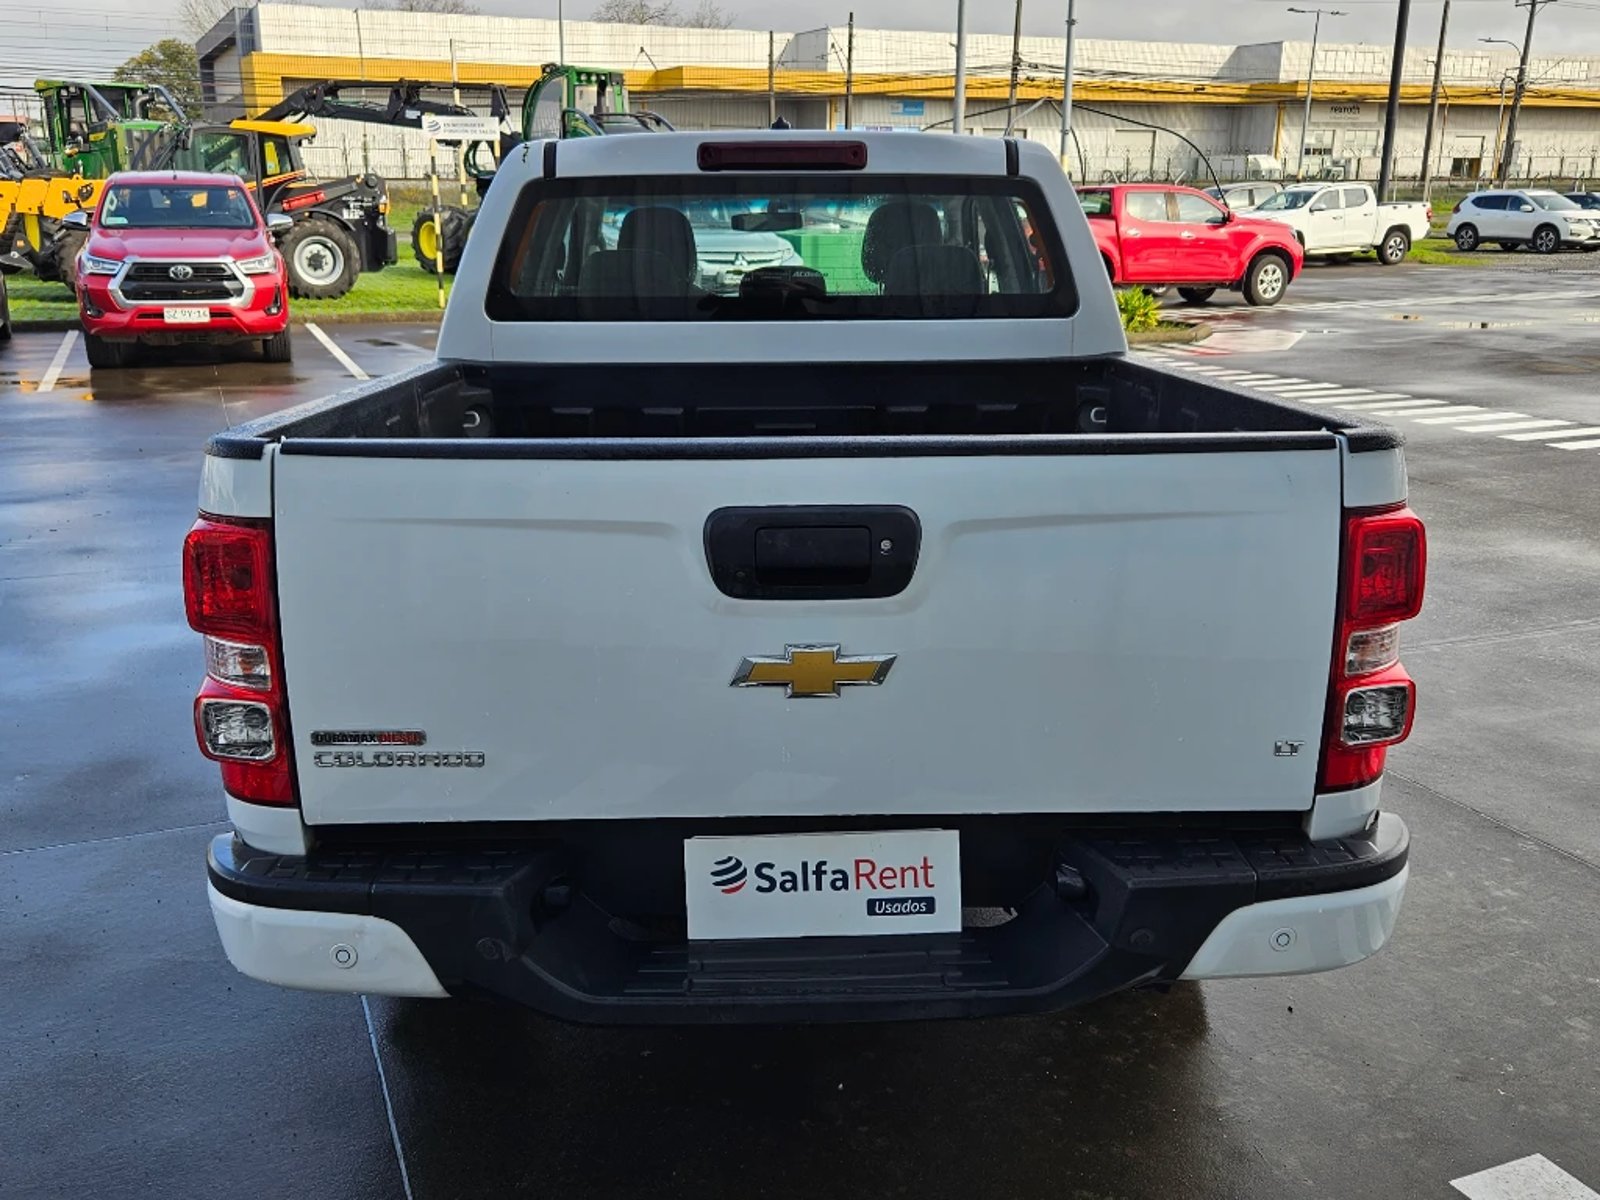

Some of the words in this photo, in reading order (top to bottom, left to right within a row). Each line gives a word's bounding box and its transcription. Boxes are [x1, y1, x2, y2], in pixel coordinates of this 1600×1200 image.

[315, 732, 378, 744] DURAMAX
[1274, 740, 1305, 757] LT
[313, 751, 485, 767] COLORADO
[874, 899, 927, 915] Usados
